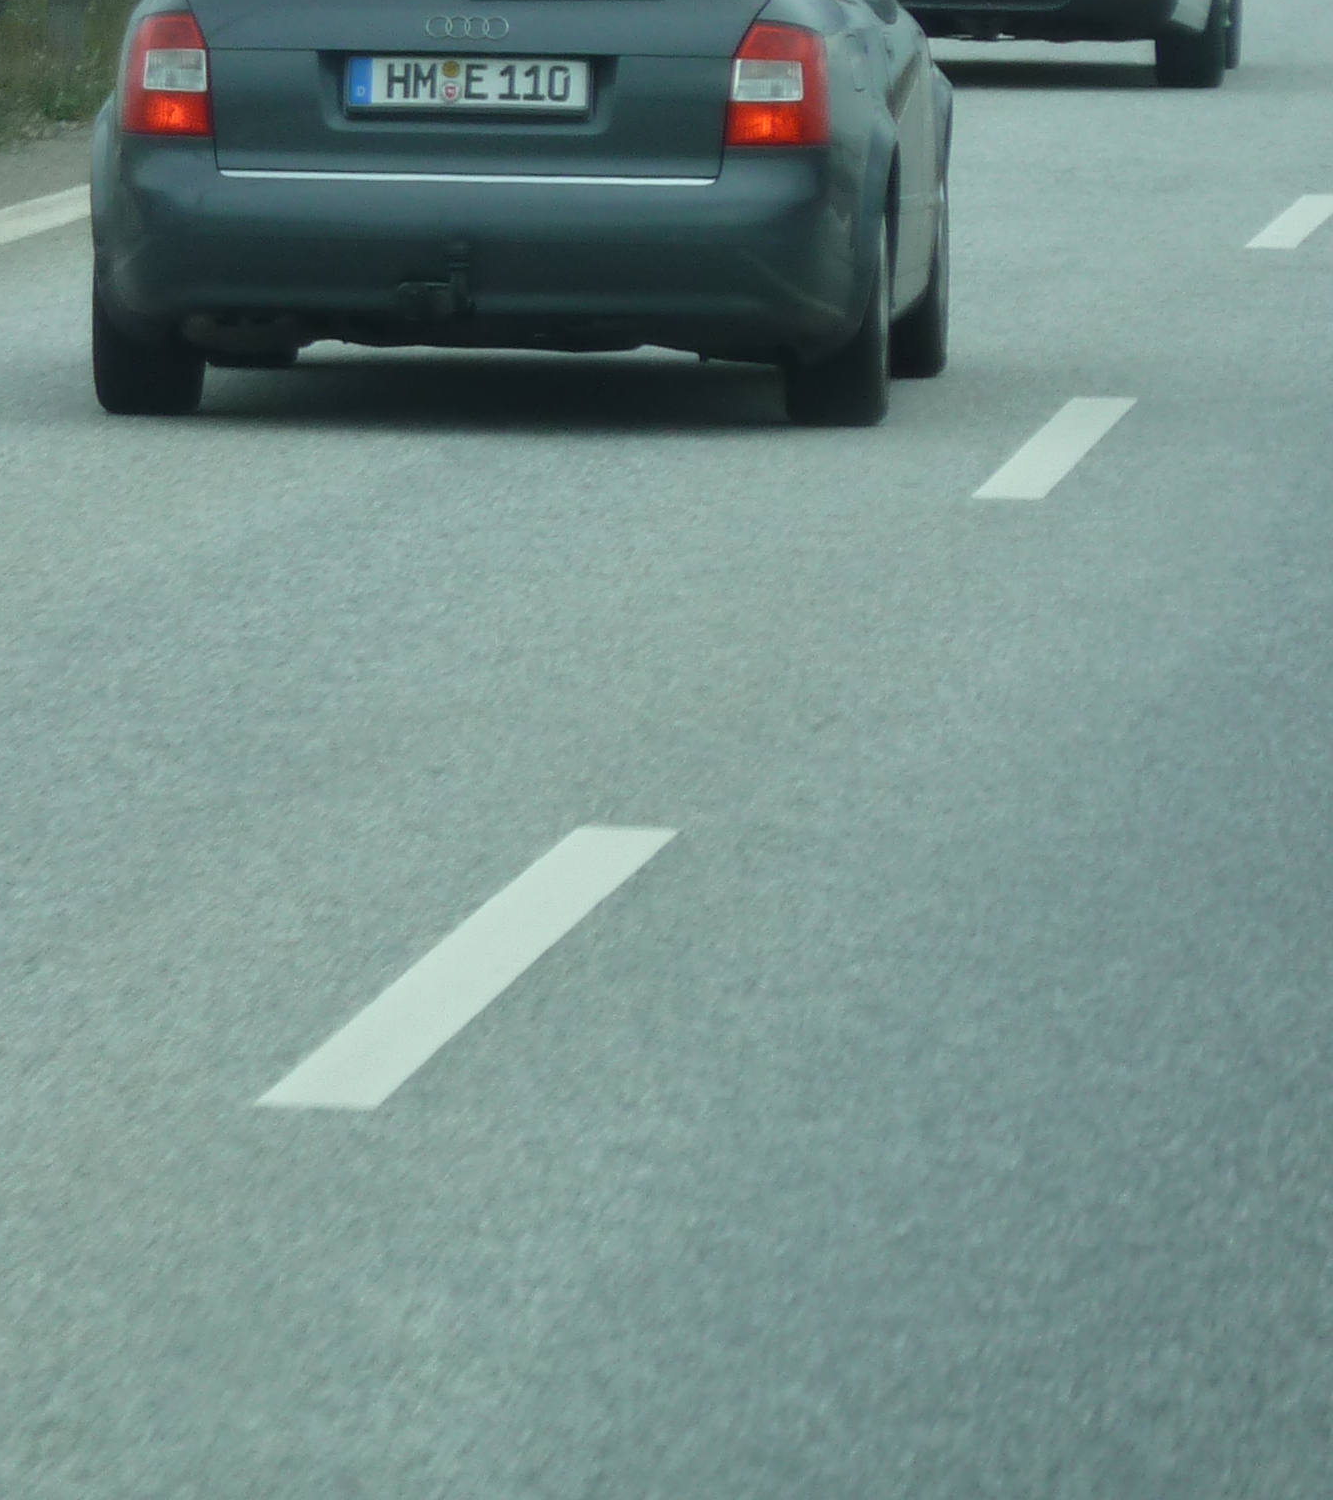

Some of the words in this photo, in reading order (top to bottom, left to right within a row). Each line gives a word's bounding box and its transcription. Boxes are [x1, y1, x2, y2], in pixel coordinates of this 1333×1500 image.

[357, 86, 366, 97] D
[386, 63, 437, 99] HM
[464, 63, 488, 100] E
[498, 64, 571, 101] 110
